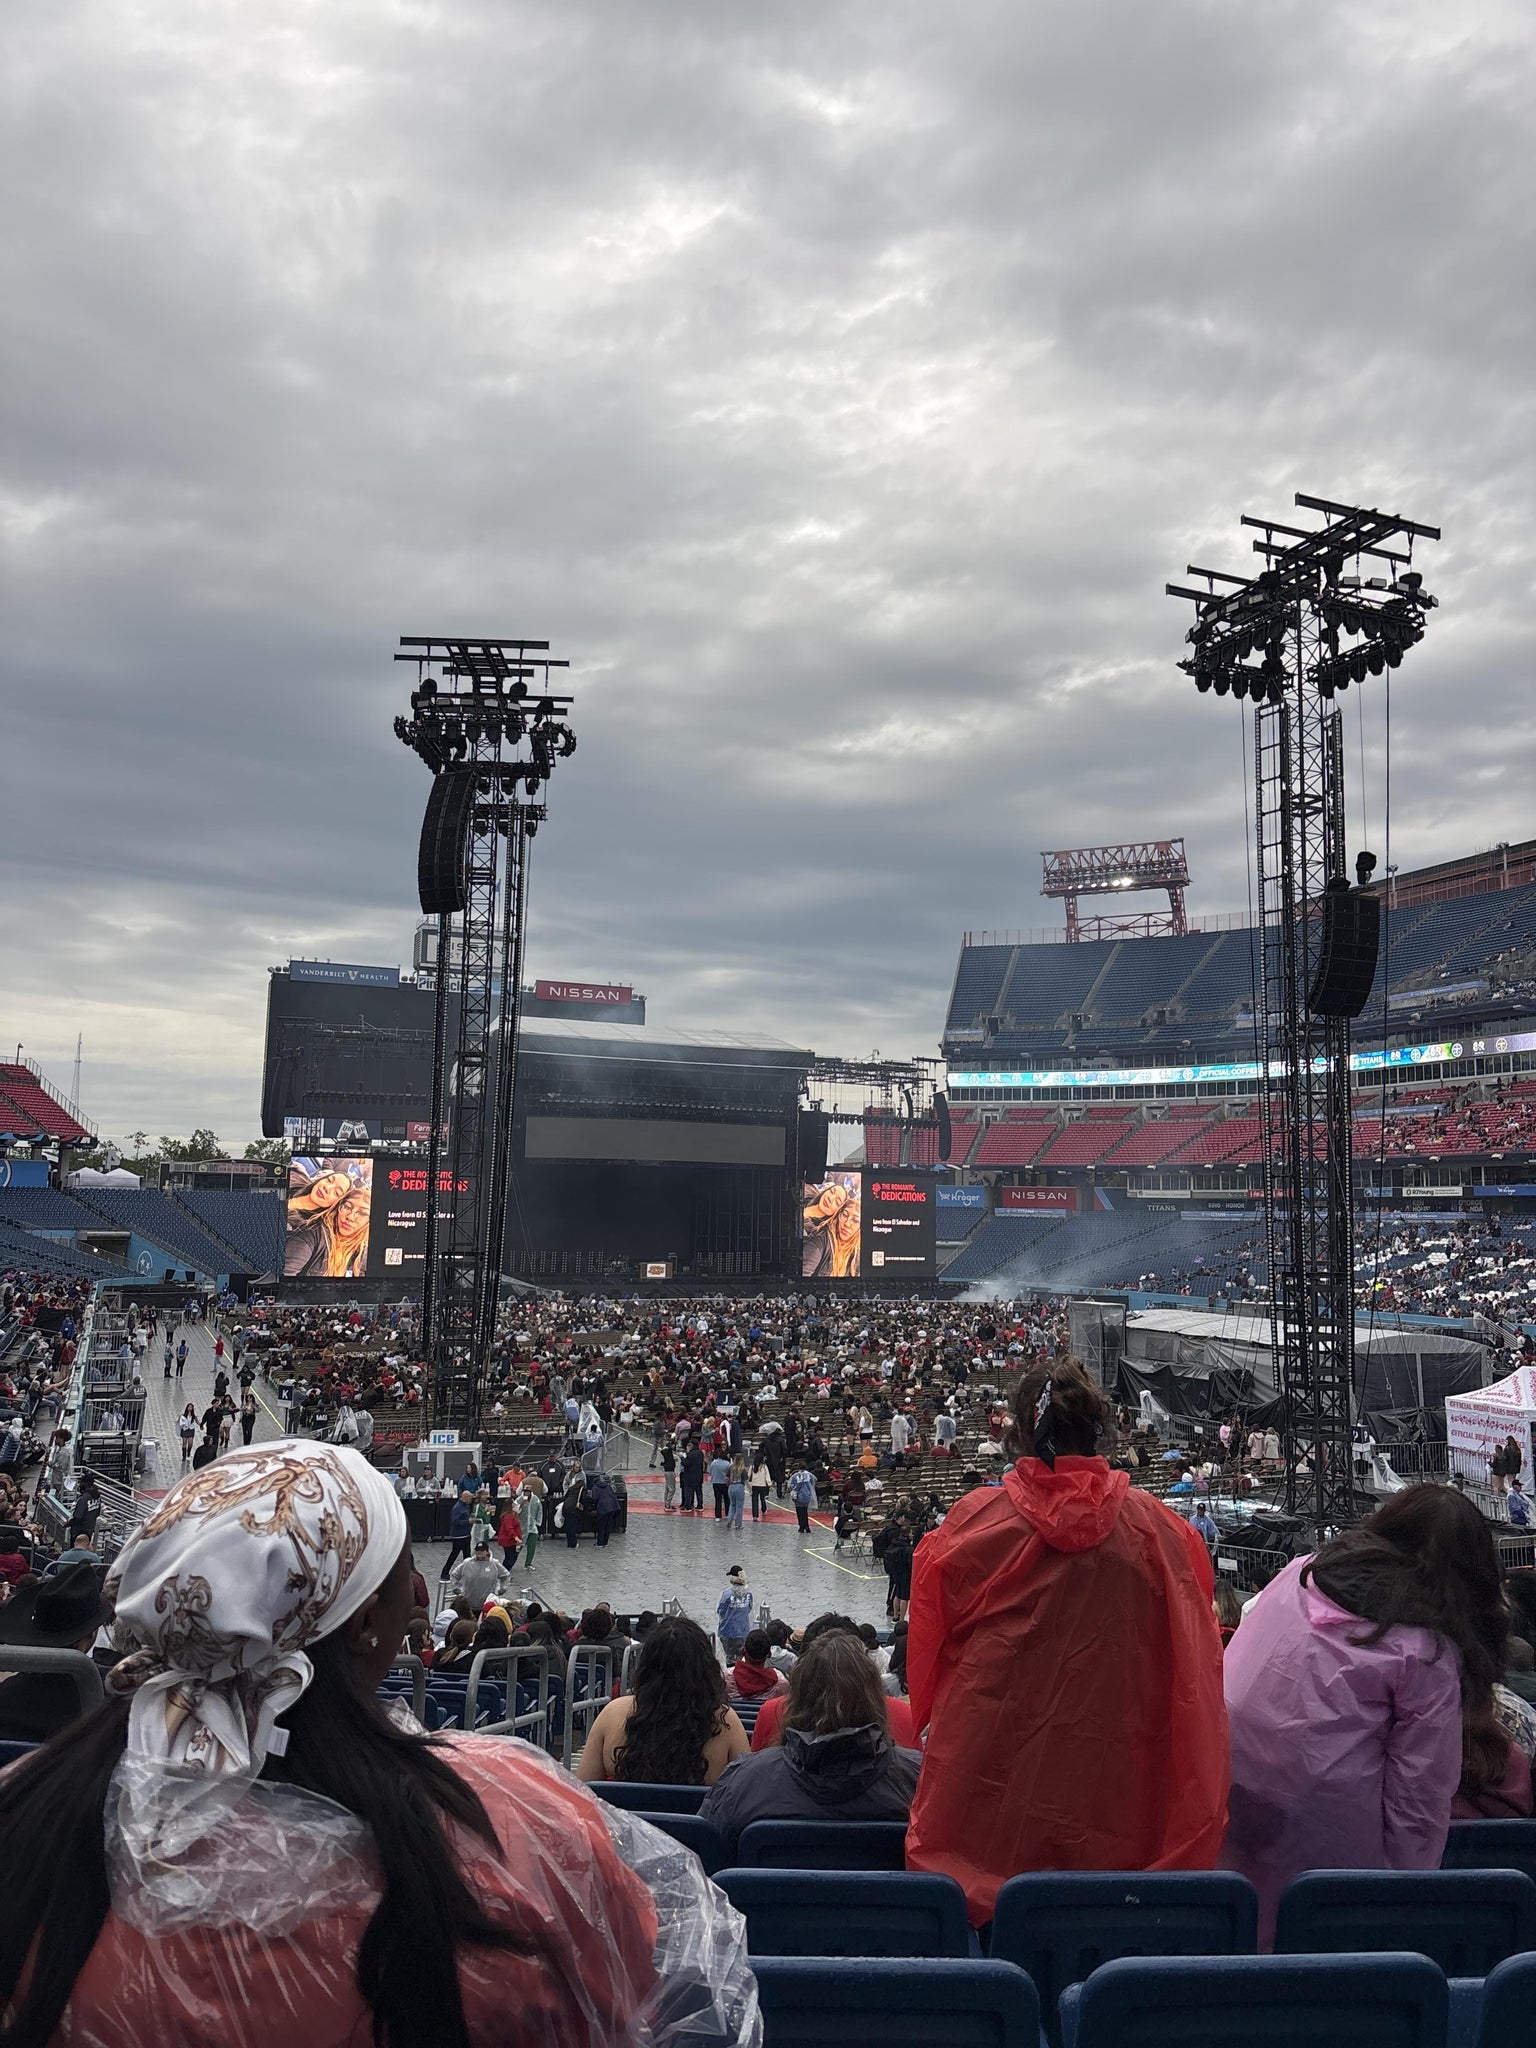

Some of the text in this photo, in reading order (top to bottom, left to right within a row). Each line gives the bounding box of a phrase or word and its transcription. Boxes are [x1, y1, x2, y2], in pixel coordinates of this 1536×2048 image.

[299, 968, 346, 978] VANDERBILT
[360, 973, 389, 981] HEALTH
[549, 986, 620, 1001] NISSAN
[1199, 1069, 1231, 1077] OFFICIAL
[403, 1170, 415, 1178] THE
[881, 1191, 926, 1202] DEDICATIONS
[952, 1189, 980, 1207] Kroger
[1011, 1191, 1067, 1200] NISSAN
[402, 1211, 415, 1219] from
[387, 1219, 416, 1228] Nicaragua
[282, 1389, 289, 1399] K
[722, 1394, 729, 1405] J
[1449, 1400, 1472, 1411] OFFICIAL
[1473, 1404, 1490, 1413] BRUNO
[1491, 1408, 1506, 1416] MARS
[1451, 1429, 1474, 1440] OFFICIAL
[1475, 1433, 1492, 1443] BRUNO
[1493, 1437, 1508, 1445] MARS
